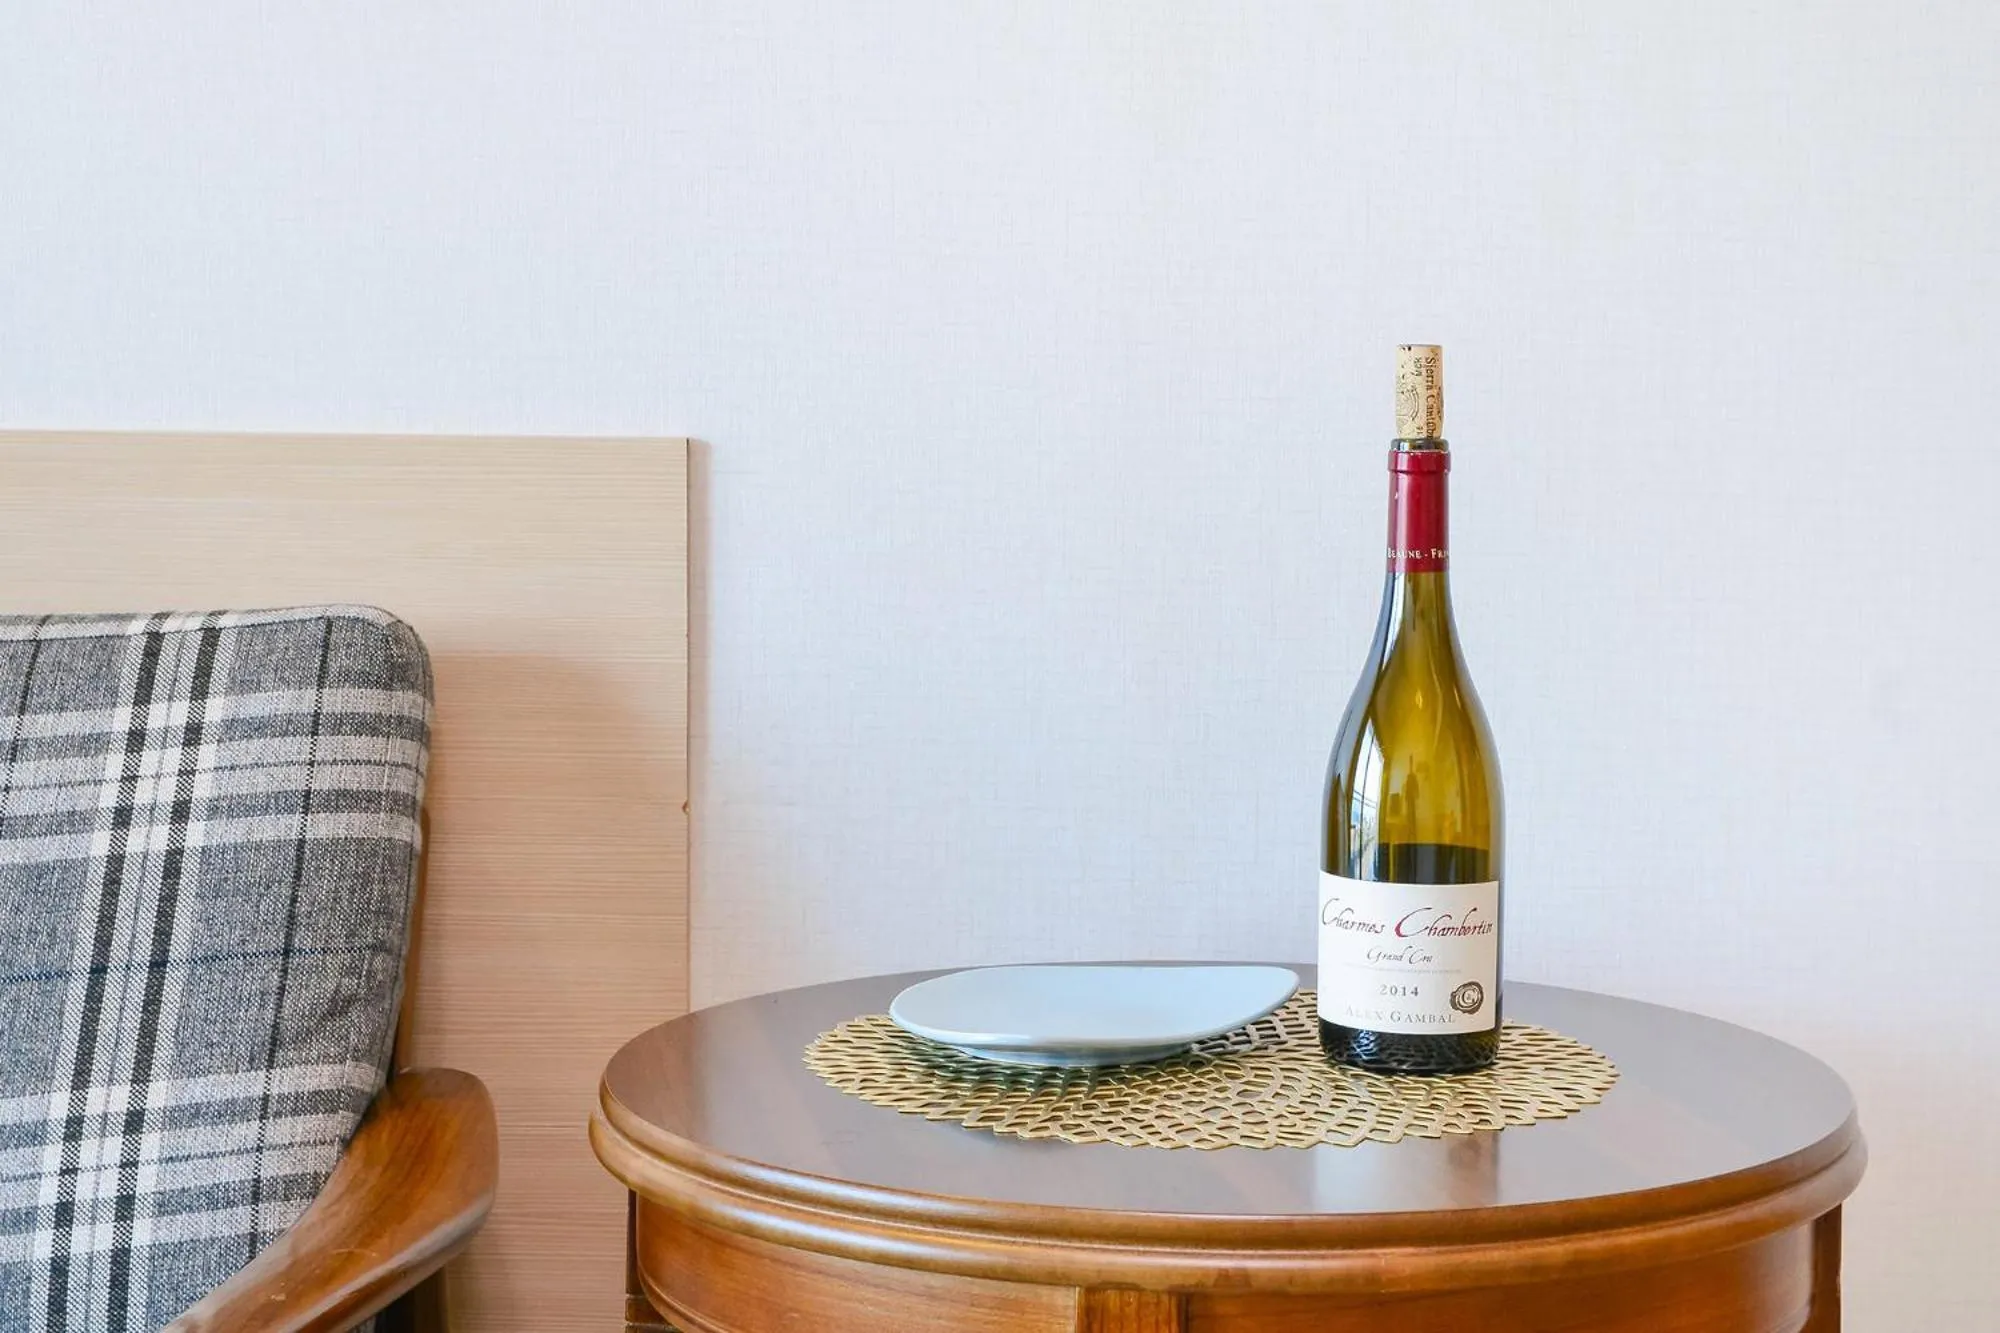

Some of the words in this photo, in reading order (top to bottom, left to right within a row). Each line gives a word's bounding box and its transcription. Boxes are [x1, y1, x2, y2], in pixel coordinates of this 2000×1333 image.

[1321, 897, 1386, 934] Charmes
[1394, 907, 1493, 938] Chambertin
[1366, 945, 1412, 965] Grand
[1408, 948, 1433, 965] Cru
[1379, 984, 1419, 997] 2014
